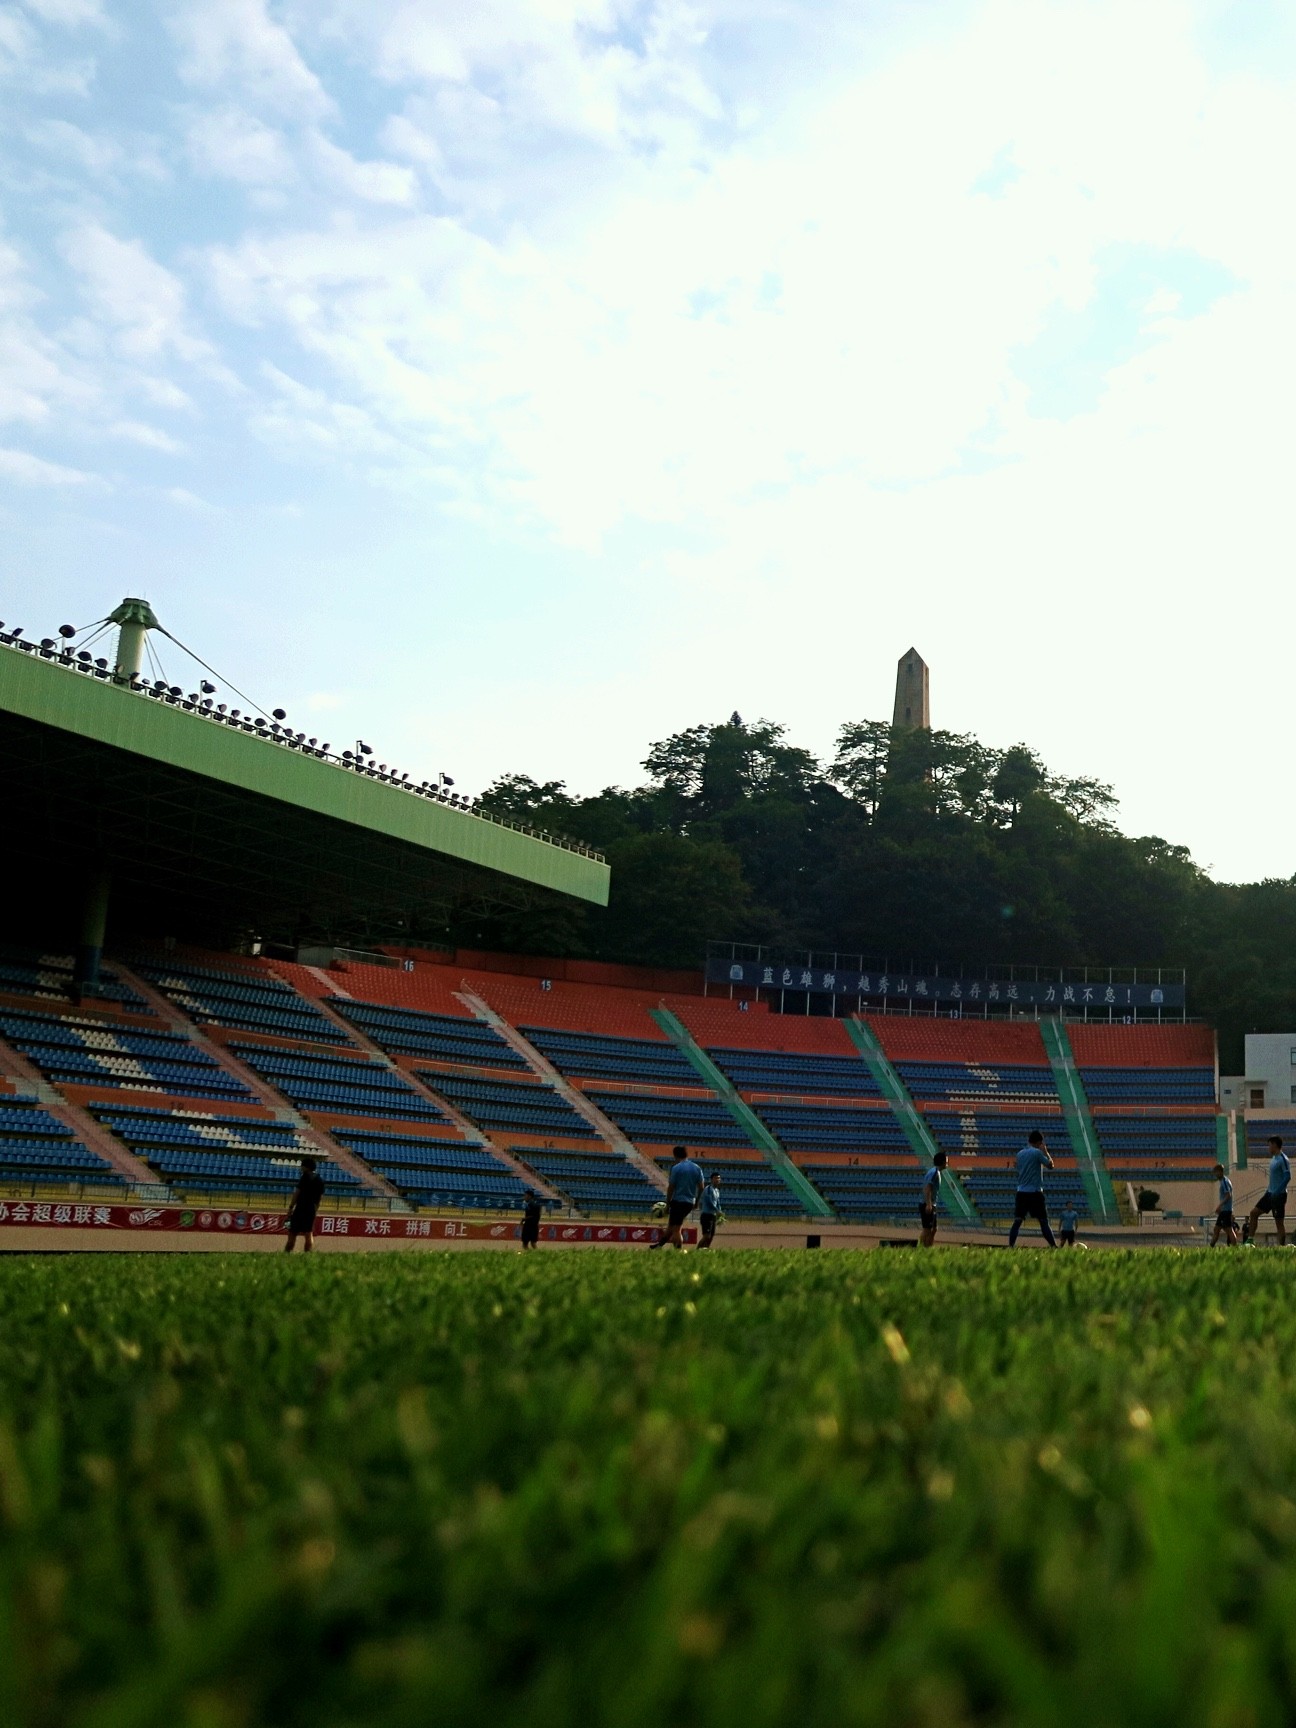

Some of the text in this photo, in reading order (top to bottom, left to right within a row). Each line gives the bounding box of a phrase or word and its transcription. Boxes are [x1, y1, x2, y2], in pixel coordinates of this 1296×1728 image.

[404, 959, 414, 972] 16
[541, 979, 552, 991] 15
[738, 1000, 749, 1012] 14
[949, 1009, 959, 1019] 13
[1122, 1015, 1132, 1025] 12
[848, 1157, 860, 1166] 14
[321, 1217, 468, 1237] 团结 欢乐 拼搏 向上
